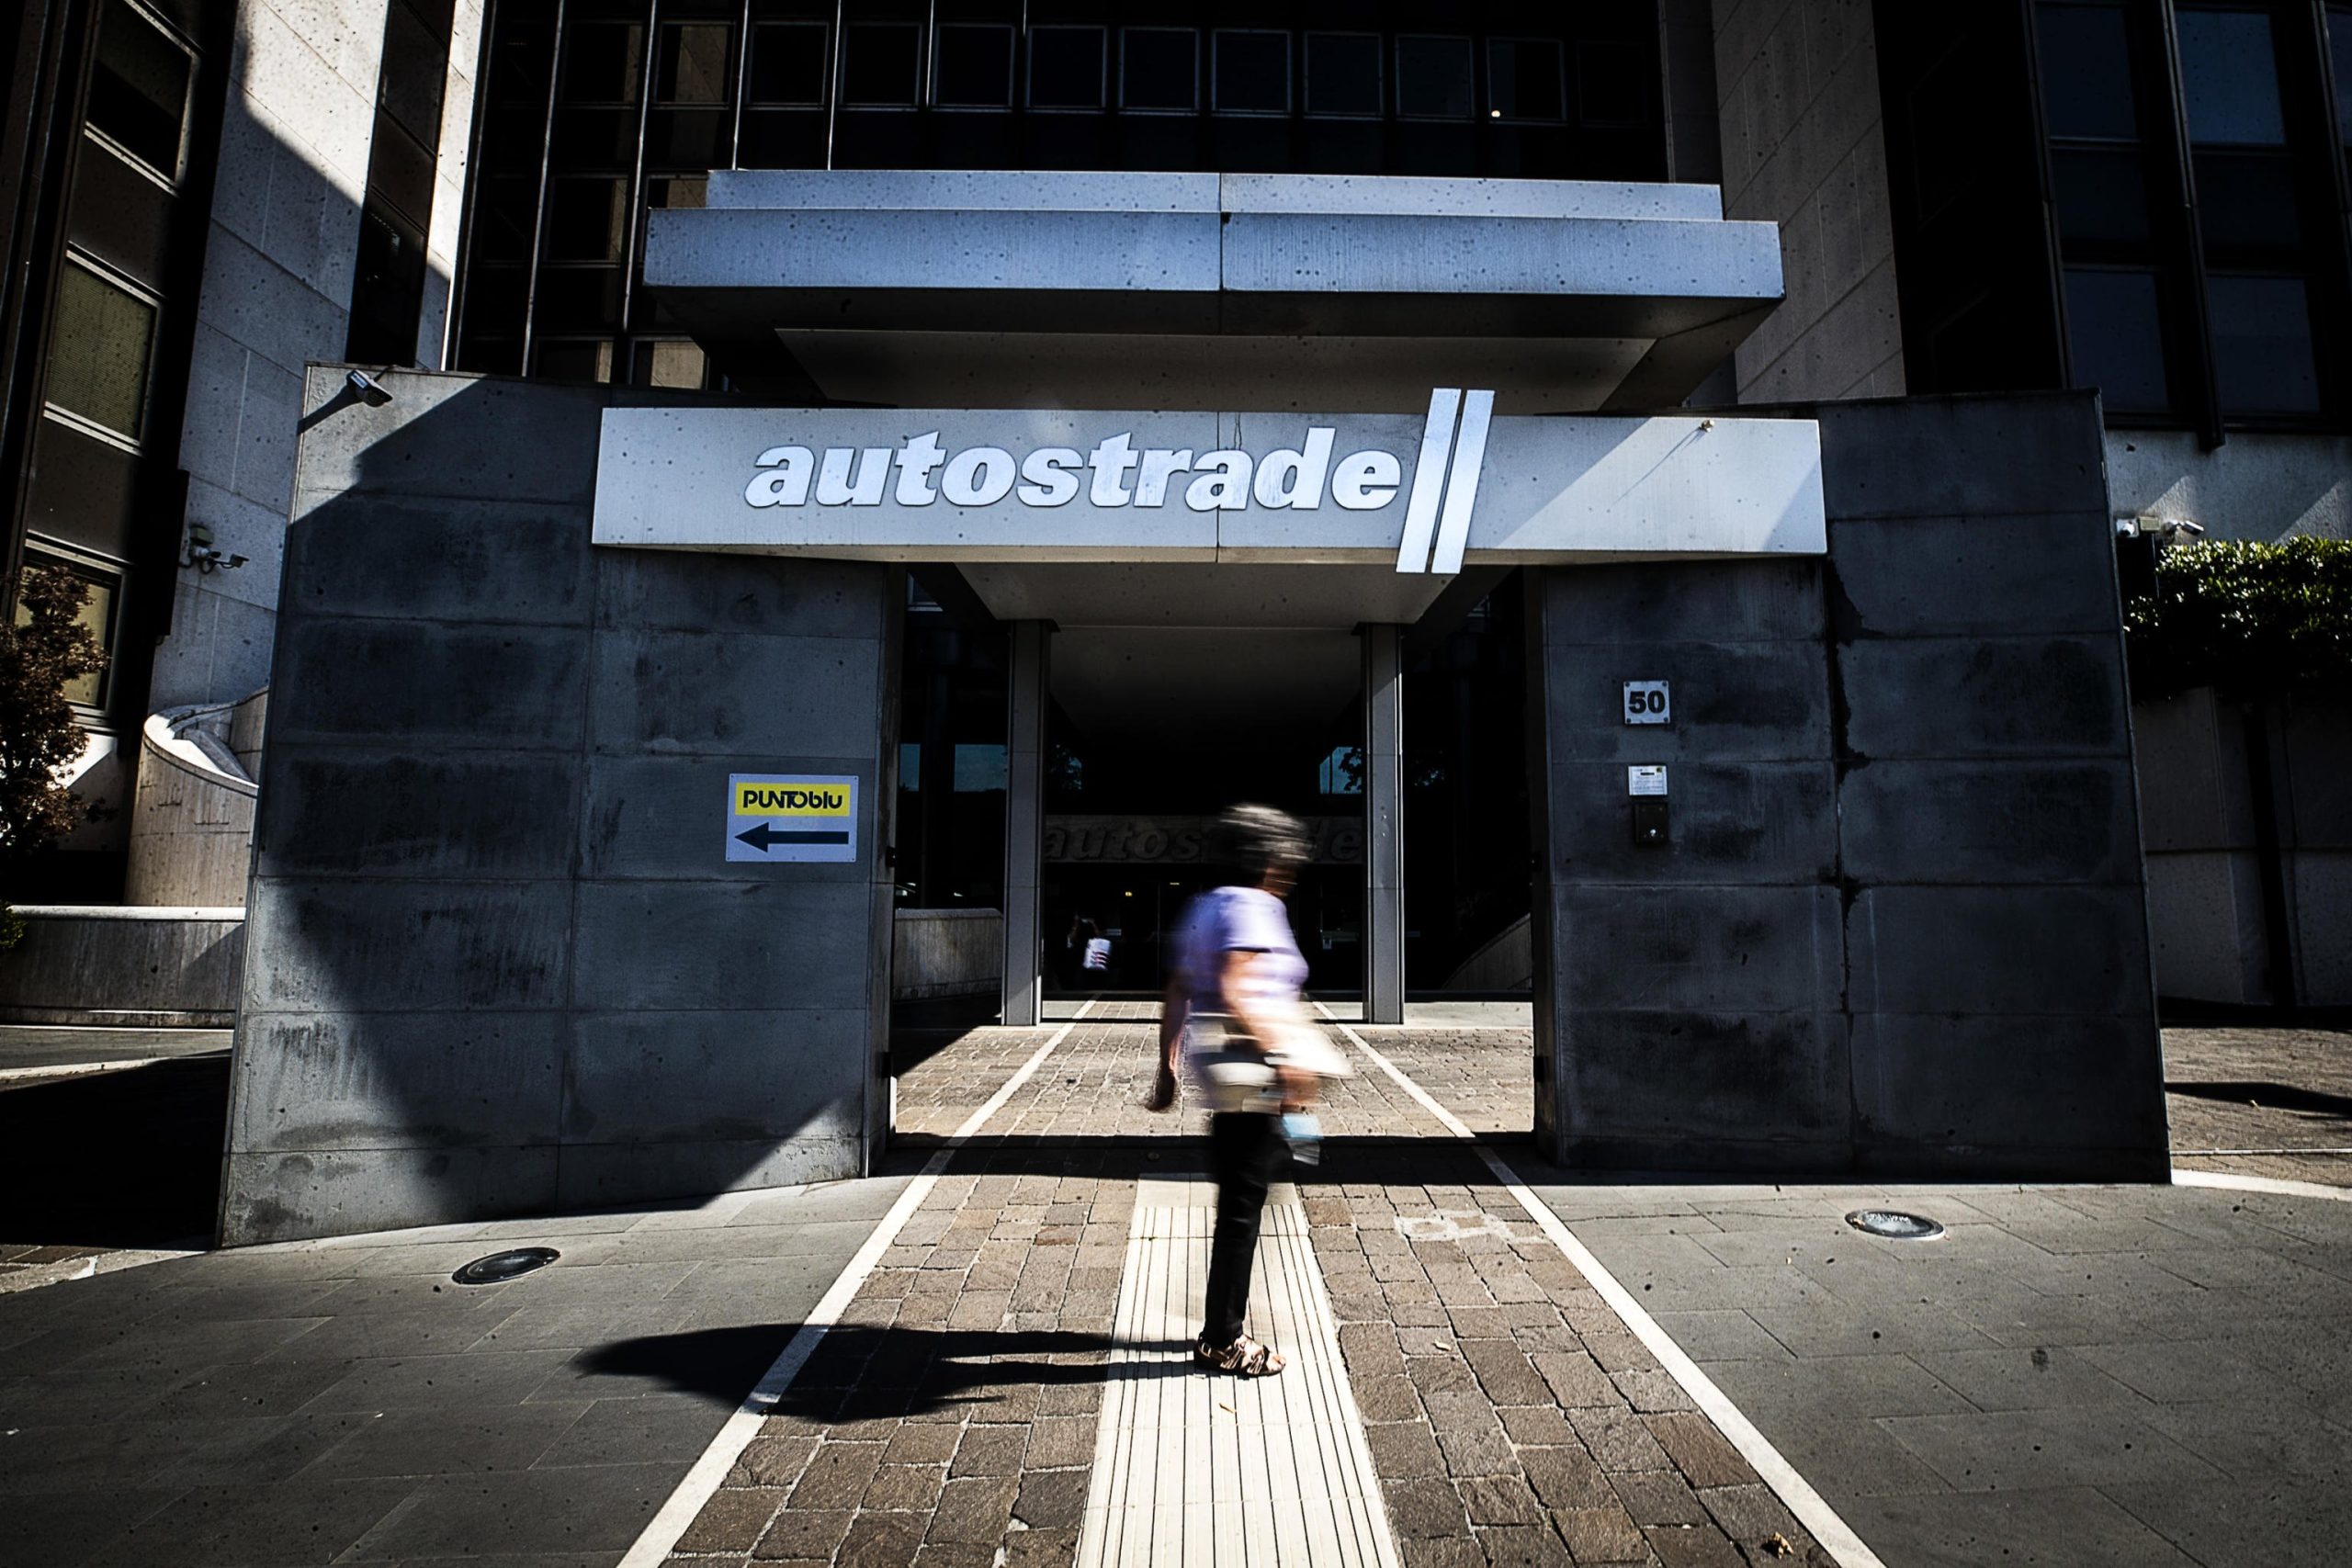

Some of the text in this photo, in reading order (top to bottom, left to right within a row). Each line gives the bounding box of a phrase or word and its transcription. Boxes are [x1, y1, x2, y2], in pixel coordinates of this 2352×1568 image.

[745, 427, 1401, 511] autostrade
[1629, 690, 1666, 714] 50
[1045, 818, 1362, 860] autosde
